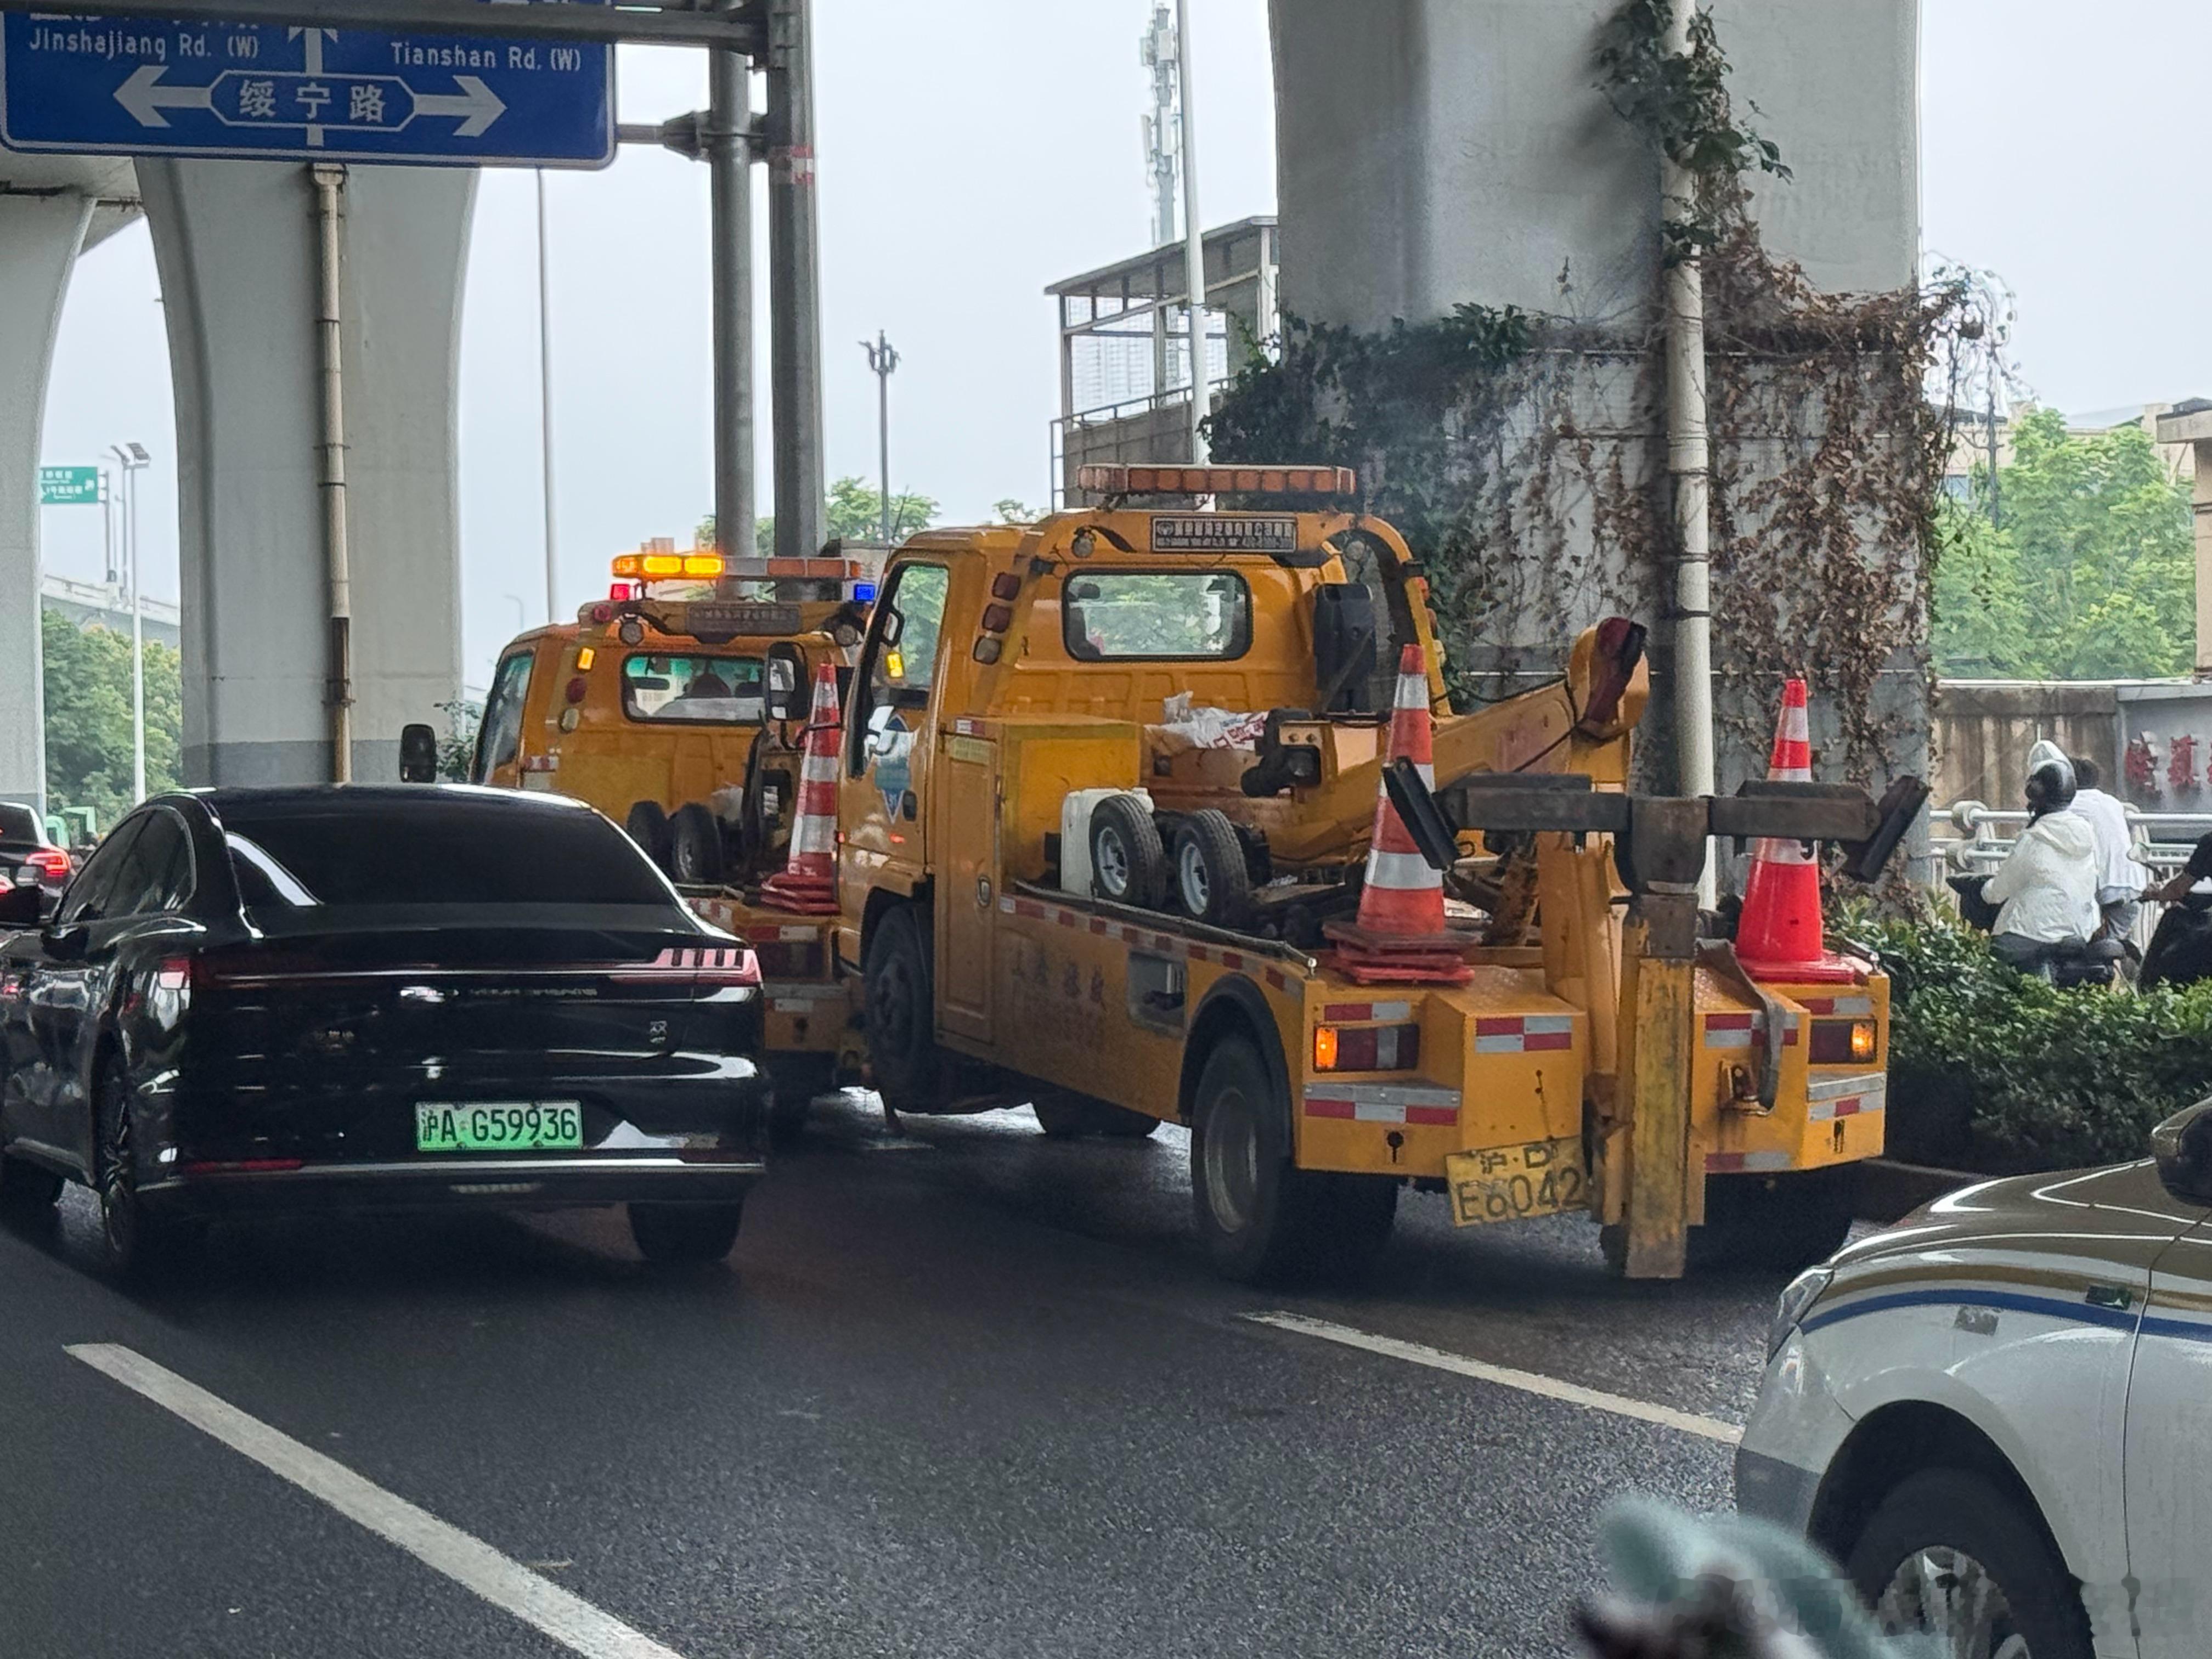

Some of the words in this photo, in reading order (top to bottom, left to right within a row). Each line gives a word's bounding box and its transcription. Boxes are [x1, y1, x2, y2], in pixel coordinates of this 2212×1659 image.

[179, 33, 212, 57] Rd.
[227, 35, 259, 59] (W)
[390, 41, 496, 67] Tianshan
[508, 46, 542, 71] Rd.
[550, 48, 582, 72] (W)
[239, 80, 387, 122] 绥宁路
[471, 1108, 577, 1142] G59936
